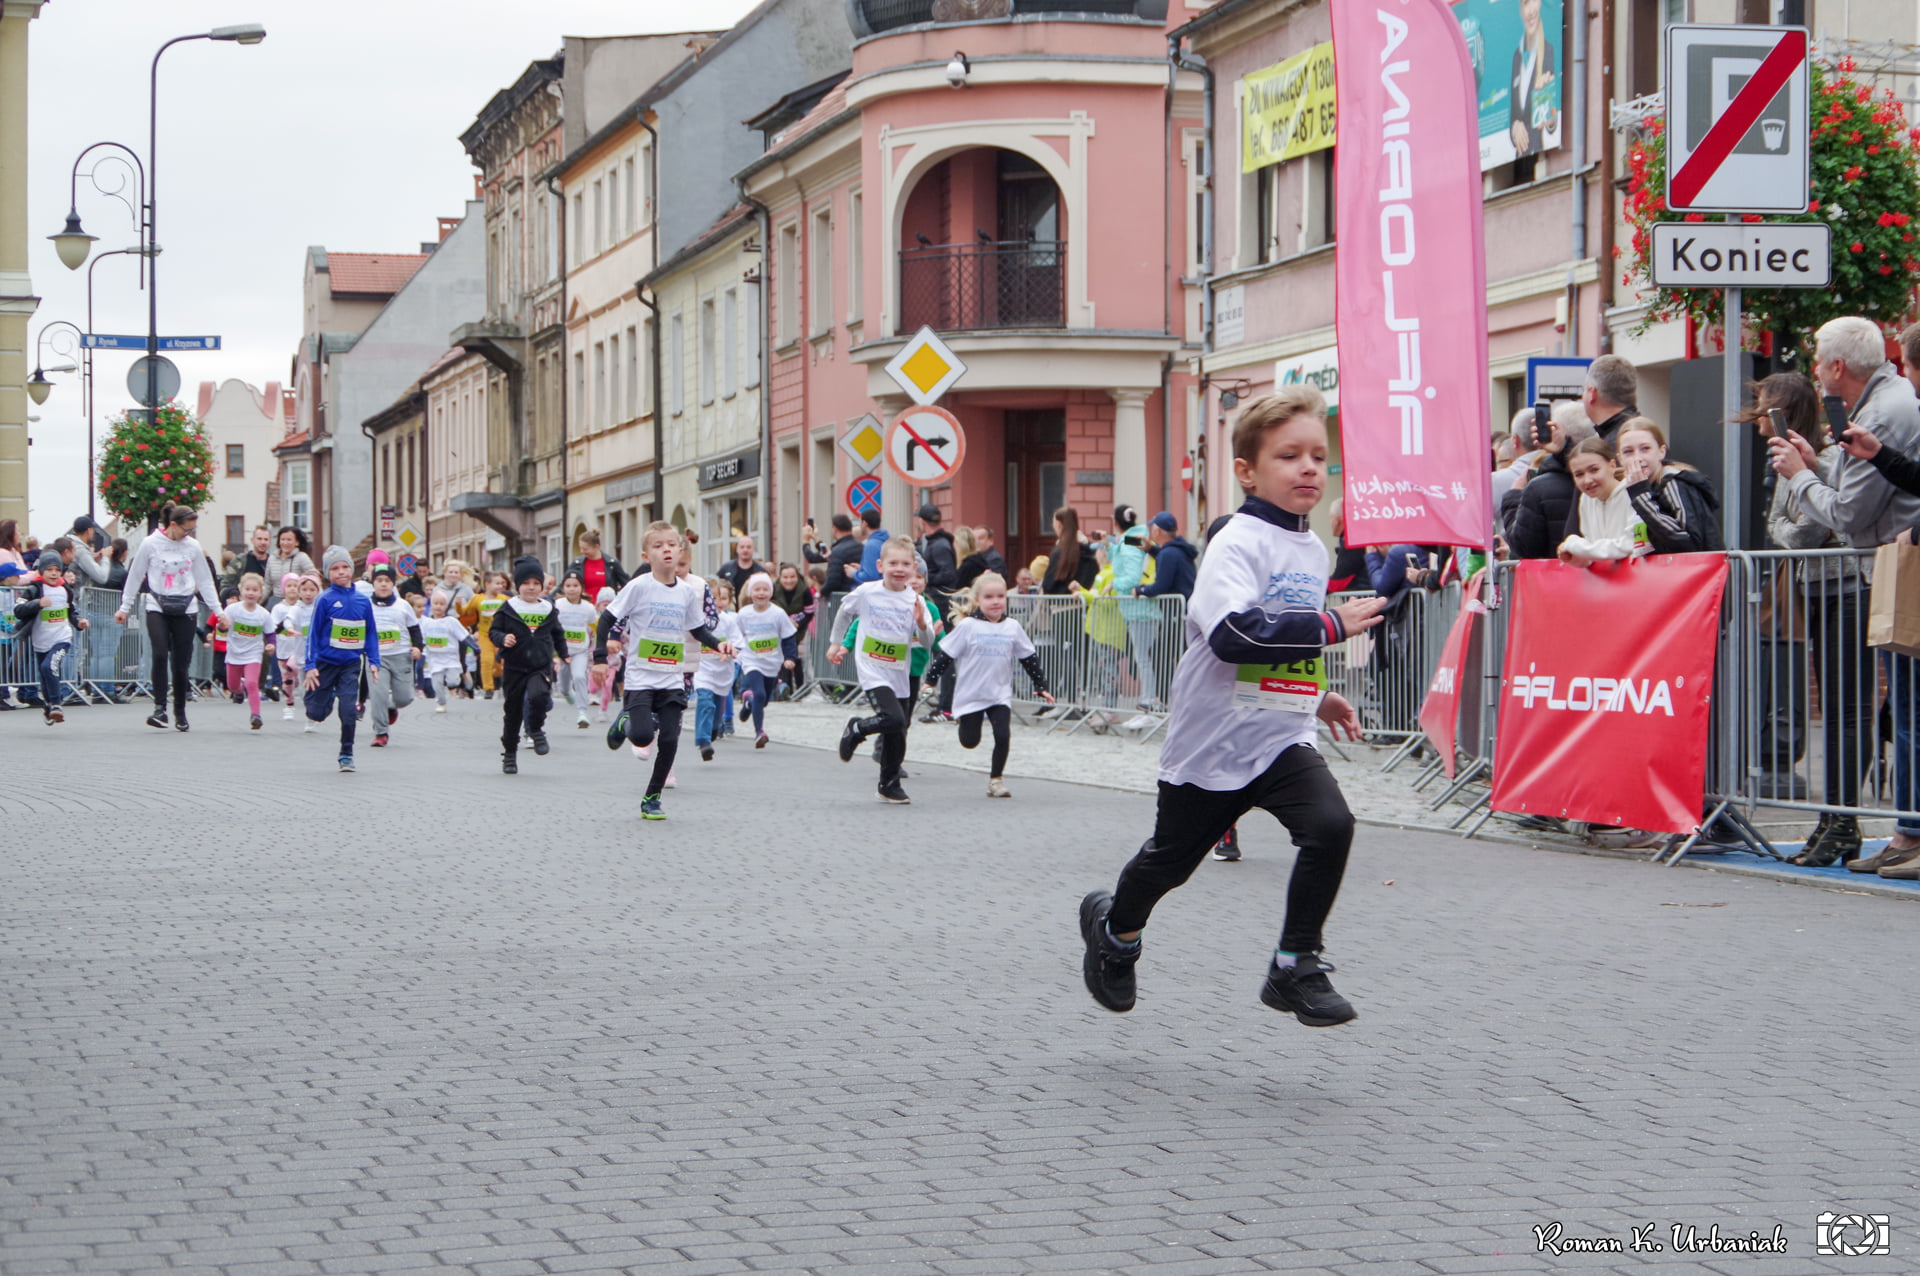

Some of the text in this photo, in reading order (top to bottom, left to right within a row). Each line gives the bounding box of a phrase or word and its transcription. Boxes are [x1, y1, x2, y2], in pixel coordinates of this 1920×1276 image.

[1672, 238, 1811, 272] Koniec
[717, 458, 739, 479] SECRET
[523, 614, 544, 625] 449
[341, 627, 359, 637] 862
[652, 643, 678, 657] 764
[874, 641, 896, 655] 716
